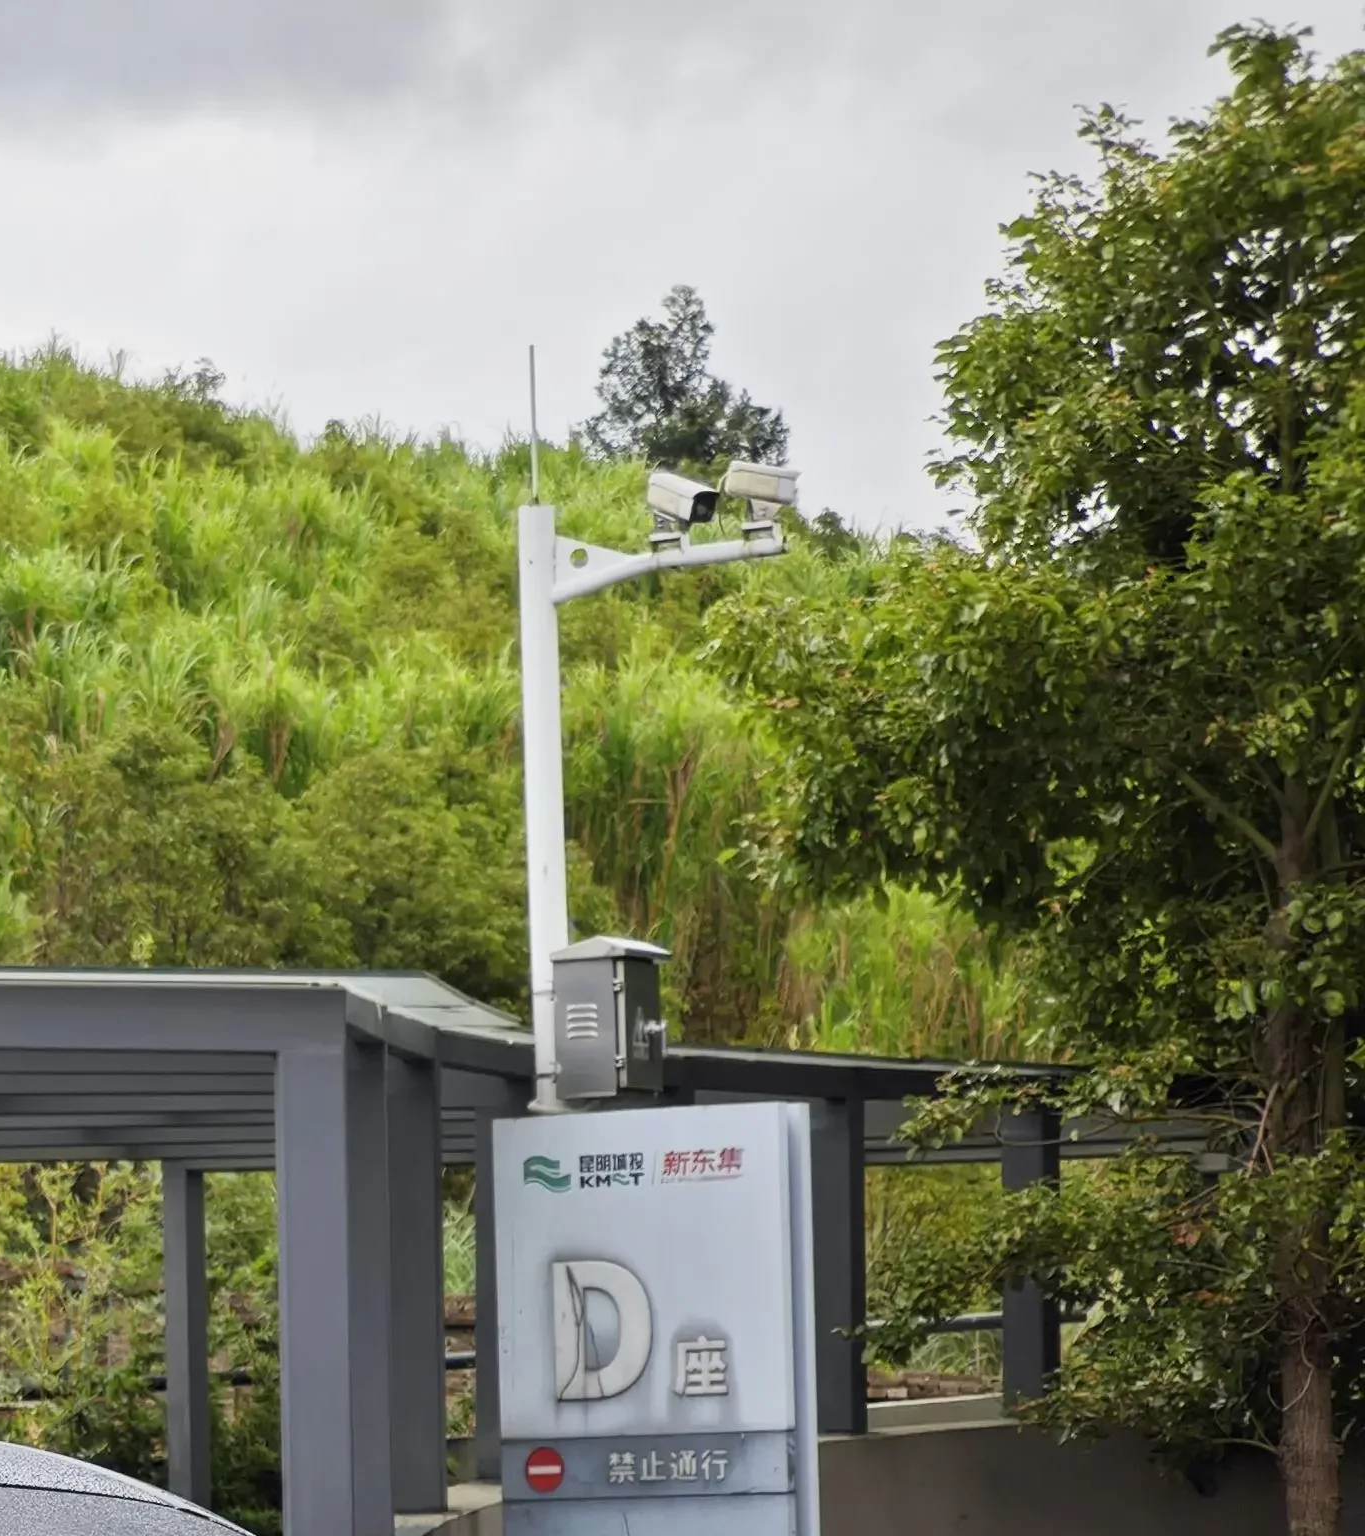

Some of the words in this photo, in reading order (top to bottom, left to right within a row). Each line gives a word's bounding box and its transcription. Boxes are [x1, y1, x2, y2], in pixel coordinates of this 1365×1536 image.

[579, 1152, 645, 1173] 昆明城投
[608, 1449, 729, 1484] 禁止通行
